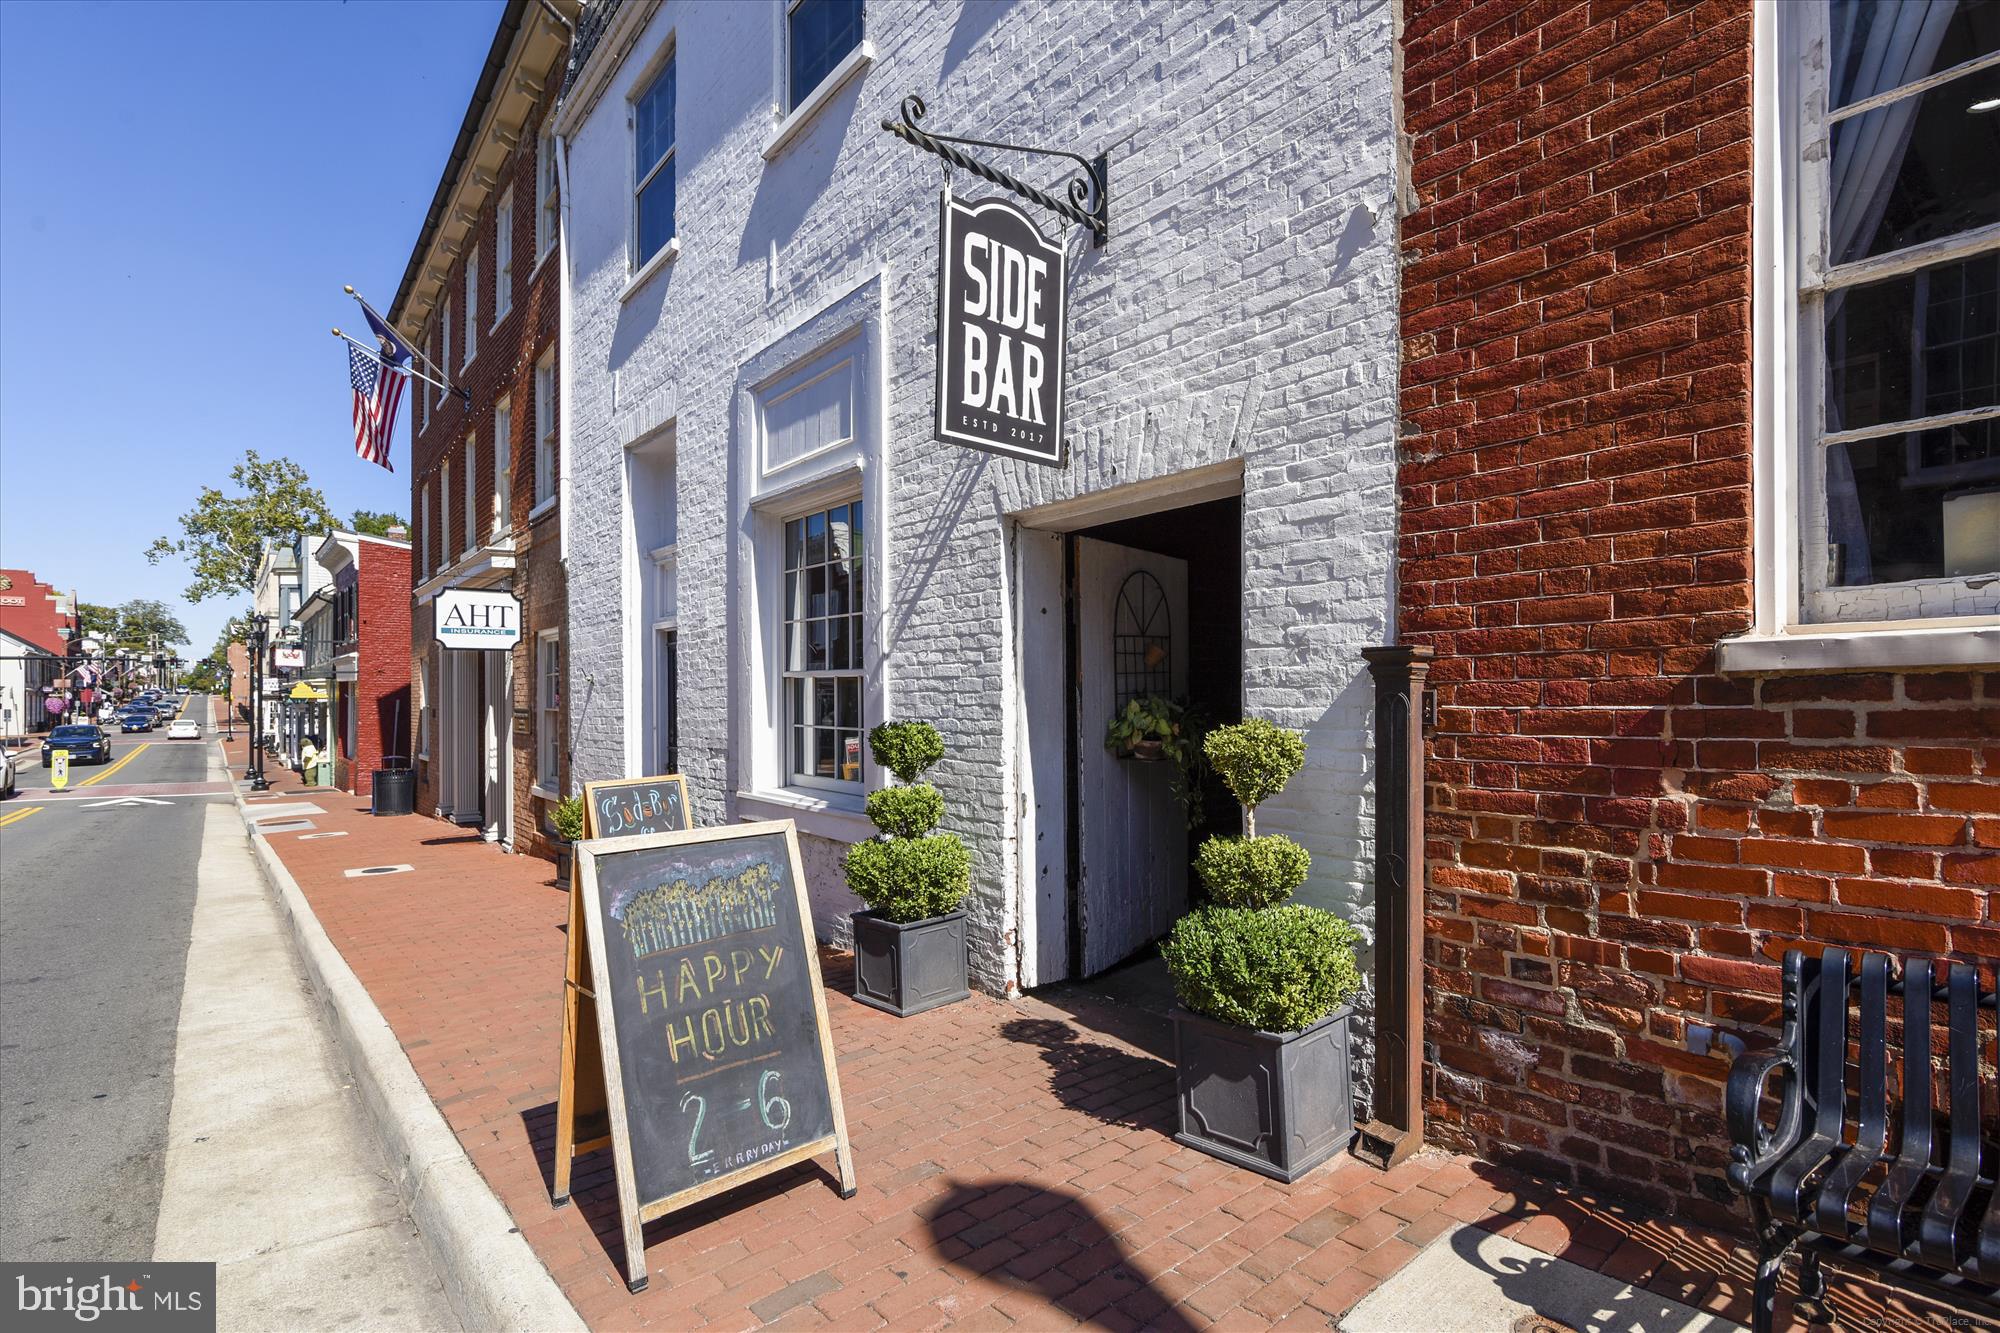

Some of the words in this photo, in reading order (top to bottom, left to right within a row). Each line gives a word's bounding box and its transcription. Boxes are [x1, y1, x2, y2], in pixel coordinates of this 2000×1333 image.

[964, 232, 1047, 339] SIDE
[961, 321, 1047, 425] BAR
[963, 416, 998, 433] ESTD
[1011, 427, 1044, 443] 2017
[444, 603, 514, 628] AHT
[450, 628, 506, 636] INSURANCE
[637, 945, 783, 1014] HAPPY
[666, 993, 776, 1064] HOUR
[680, 1090, 714, 1167] 2
[757, 1070, 791, 1131] 6
